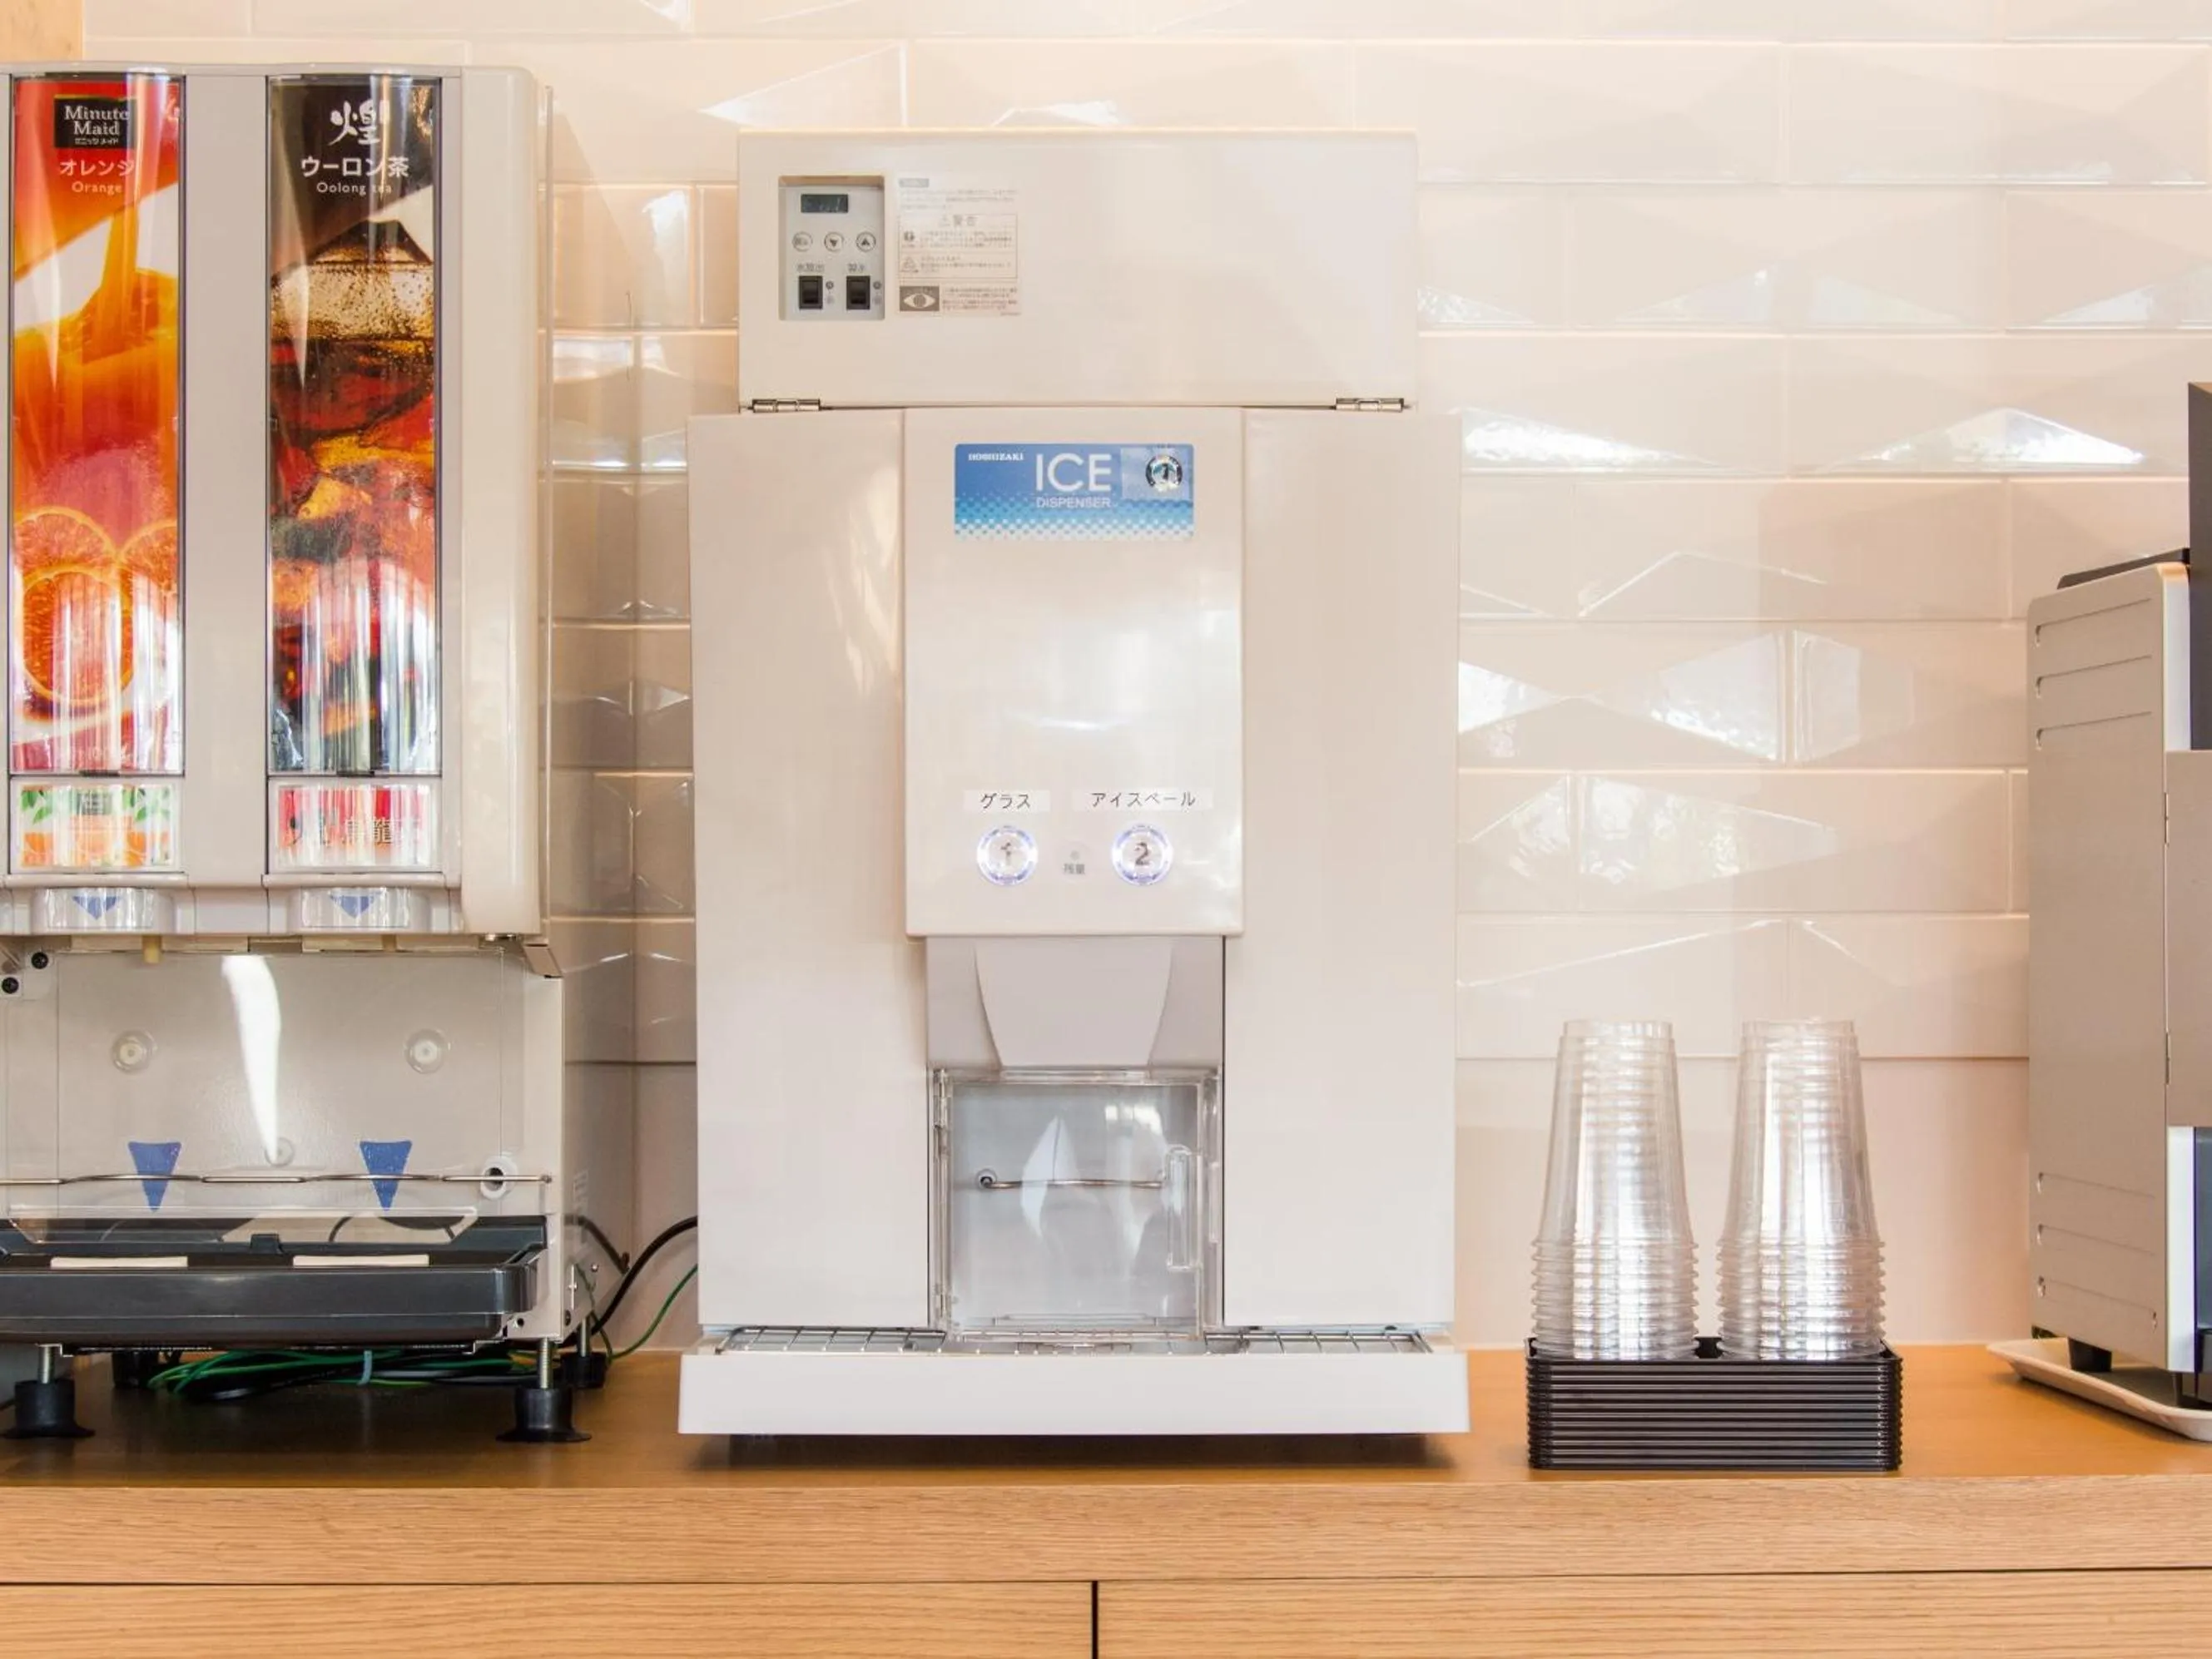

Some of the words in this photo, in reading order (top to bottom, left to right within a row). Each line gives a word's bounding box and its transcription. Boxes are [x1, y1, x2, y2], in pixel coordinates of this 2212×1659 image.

[64, 105, 130, 120] Minute
[73, 120, 120, 135] Maid
[60, 159, 134, 176] オレンジ
[301, 156, 409, 178] ウーロン茶
[72, 181, 122, 196] Orange
[316, 181, 366, 196] Oolong
[1036, 453, 1112, 492] ICE
[1036, 497, 1111, 508] DISPENSER
[980, 793, 1031, 809] グラス
[1091, 791, 1196, 808] アイスペール
[1133, 842, 1150, 866] 2
